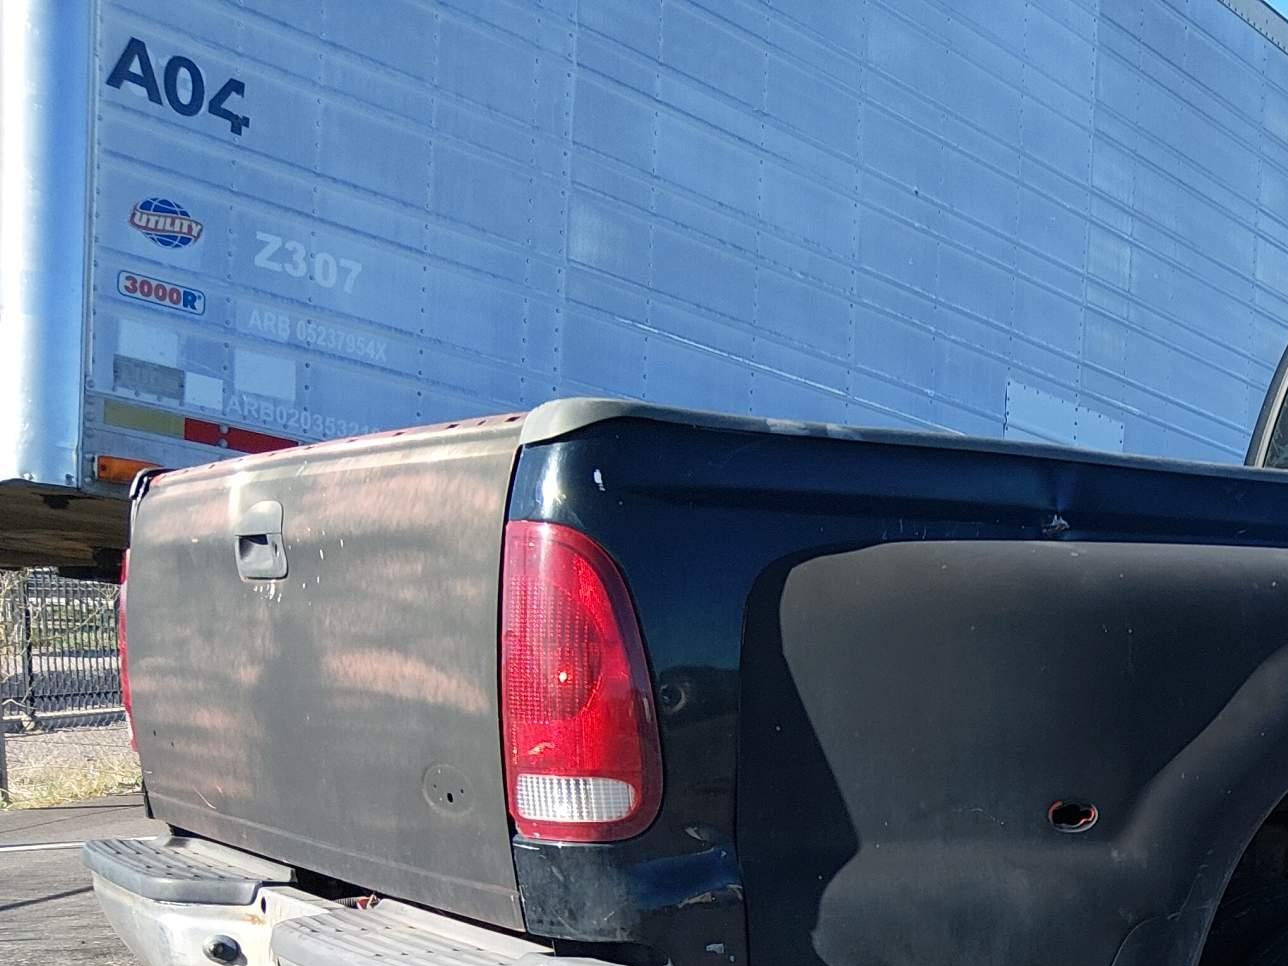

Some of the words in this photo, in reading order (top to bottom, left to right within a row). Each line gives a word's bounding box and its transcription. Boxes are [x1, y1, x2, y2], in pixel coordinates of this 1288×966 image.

[105, 36, 250, 136] A04
[134, 211, 202, 237] UTILITY
[254, 231, 362, 294] Z307
[249, 308, 290, 342] ARB
